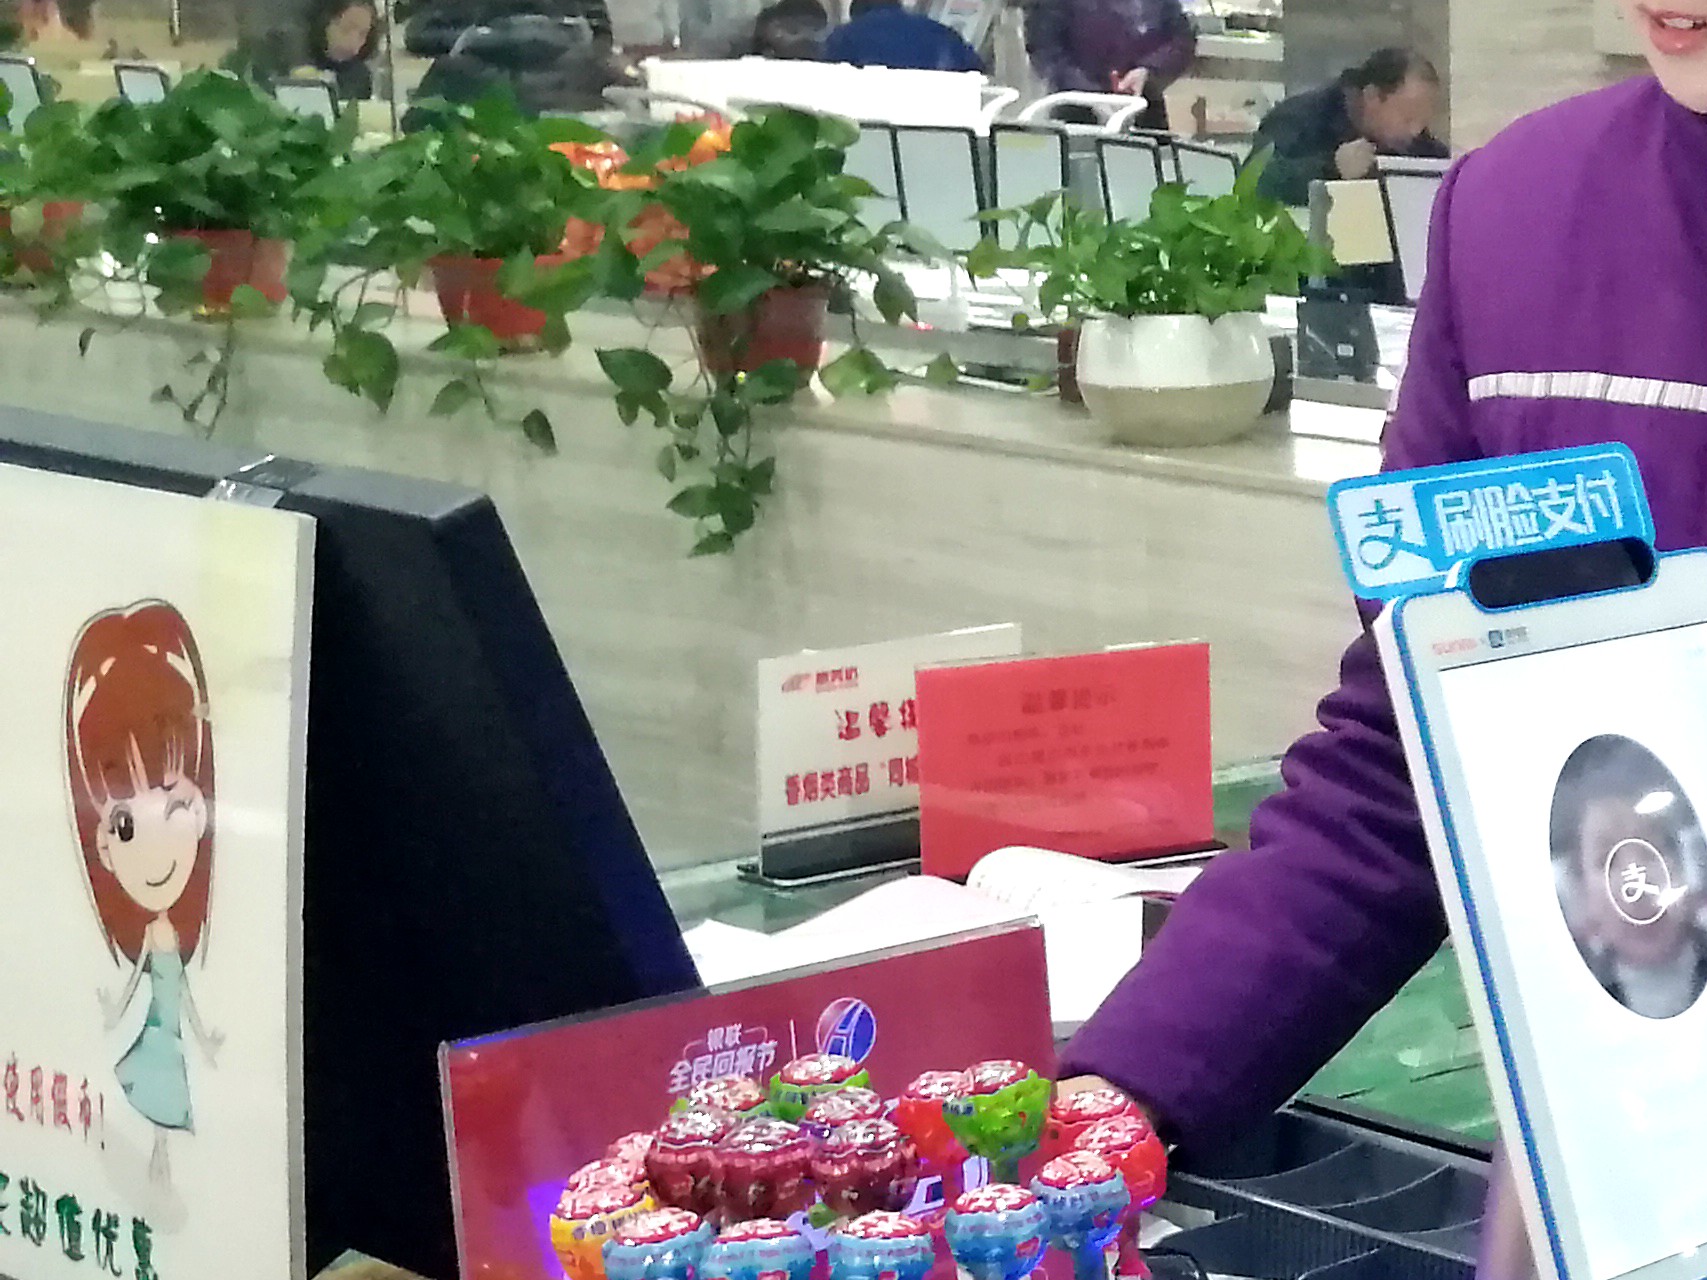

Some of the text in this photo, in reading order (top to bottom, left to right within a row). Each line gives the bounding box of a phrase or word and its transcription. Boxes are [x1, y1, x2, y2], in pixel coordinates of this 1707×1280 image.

[1434, 469, 1623, 557] 刷脸支付
[707, 1023, 743, 1052] 银联
[667, 1040, 778, 1094] 全民回报节
